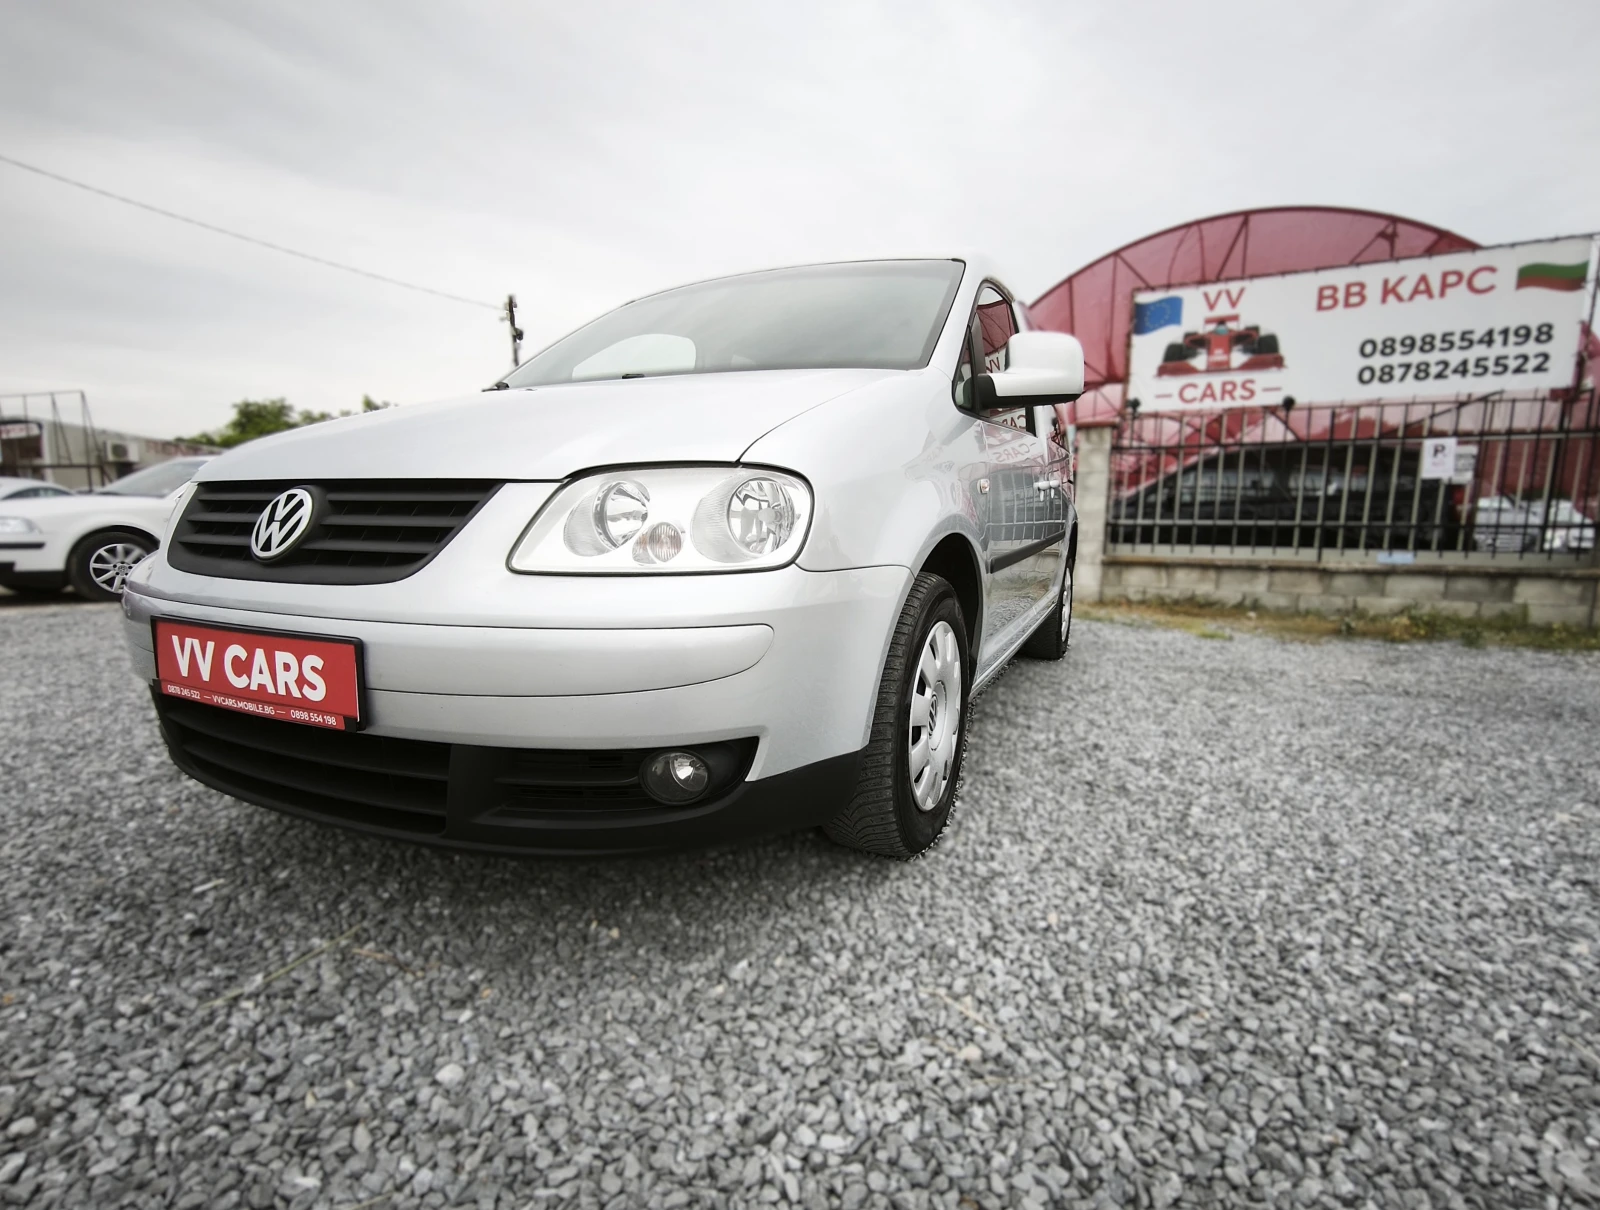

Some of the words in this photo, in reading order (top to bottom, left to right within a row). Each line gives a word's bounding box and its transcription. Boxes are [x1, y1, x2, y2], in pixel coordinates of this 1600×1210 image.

[1203, 286, 1245, 312] VV
[1316, 281, 1367, 312] ВВ
[1380, 266, 1498, 305] КАРС
[1359, 323, 1554, 359] 0898554198
[1357, 352, 1551, 385] 0878245522
[1178, 379, 1256, 404] CARS
[172, 635, 214, 681] VV
[224, 644, 327, 702] CARS
[167, 684, 181, 694] 0878
[181, 687, 191, 697] 245
[191, 690, 201, 699] 522
[212, 695, 275, 714] VVCARS.MOBILE.BG
[290, 709, 309, 721] 0898
[310, 712, 323, 723] 554
[324, 714, 337, 726] 198
